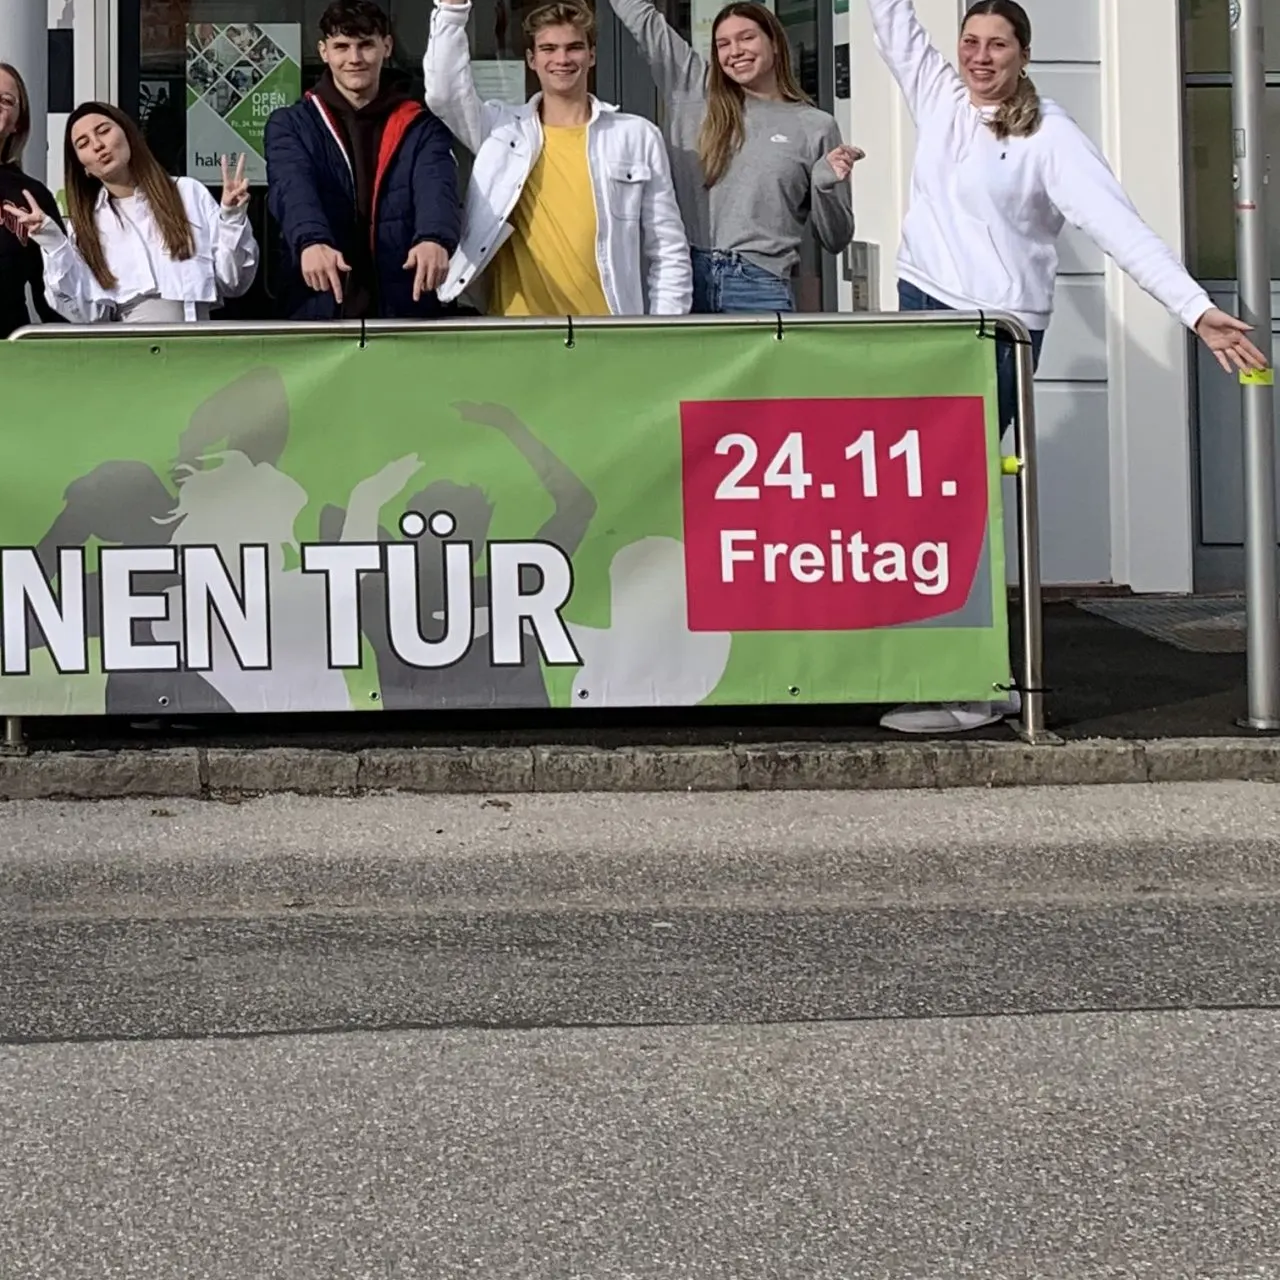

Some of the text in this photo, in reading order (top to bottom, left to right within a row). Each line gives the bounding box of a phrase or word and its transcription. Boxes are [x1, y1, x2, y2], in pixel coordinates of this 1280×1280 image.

[252, 92, 286, 105] OPEN
[195, 151, 222, 167] hak
[714, 429, 957, 500] 24.11.
[301, 510, 583, 671] TÜR
[720, 529, 950, 596] Freitag
